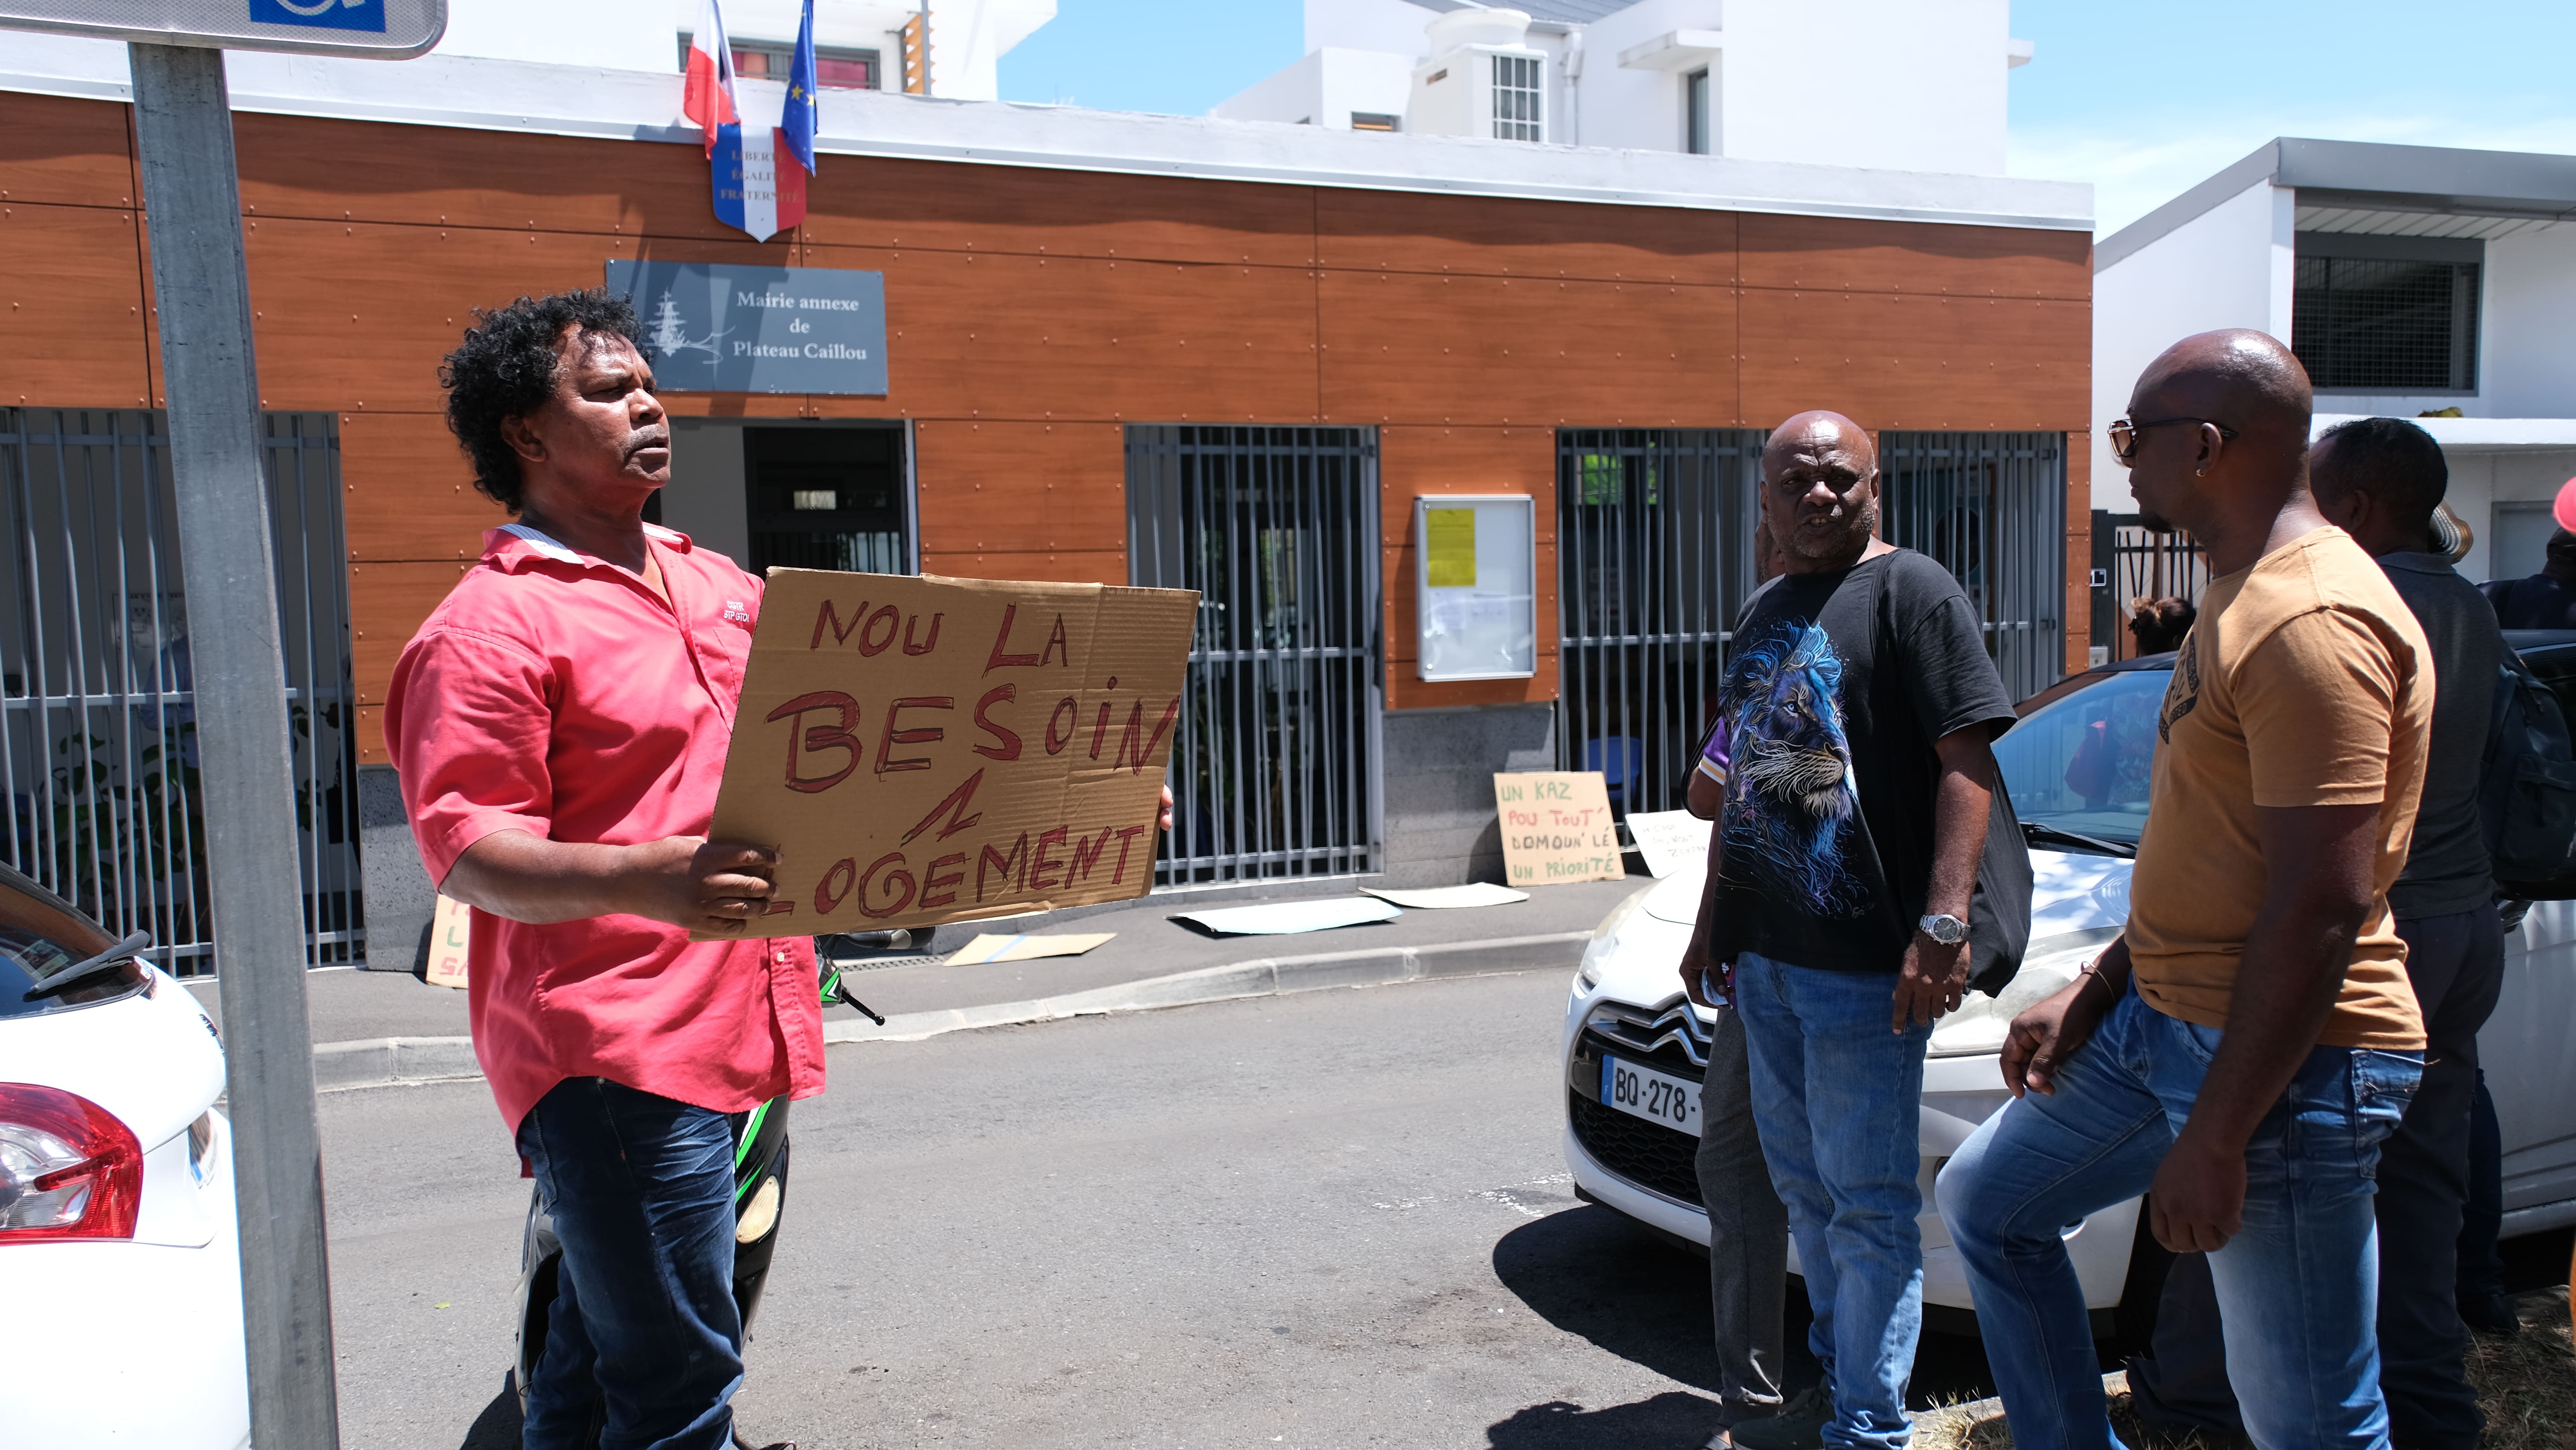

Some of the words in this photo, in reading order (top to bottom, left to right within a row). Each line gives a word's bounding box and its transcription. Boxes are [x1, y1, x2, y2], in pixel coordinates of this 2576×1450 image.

[732, 150, 786, 163] LIBERTÉ
[732, 167, 786, 183] ÉGALITÉ
[720, 188, 799, 203] FRATERNITÉ
[736, 291, 795, 308] Mairie
[799, 297, 860, 311] annexe
[789, 317, 810, 334] de
[733, 341, 800, 358] Plateau
[804, 343, 867, 360] Caillou
[727, 600, 744, 611] CGTR
[724, 610, 735, 620] BTP
[810, 599, 945, 658] NOU
[982, 602, 1069, 679] LA
[1501, 785, 1523, 802] UN
[1535, 781, 1572, 800] KAZ
[1508, 810, 1537, 826] POU
[1592, 826, 1610, 847] LÉ
[1513, 864, 1533, 879] UN
[1615, 1067, 1702, 1123] BQ-278-
